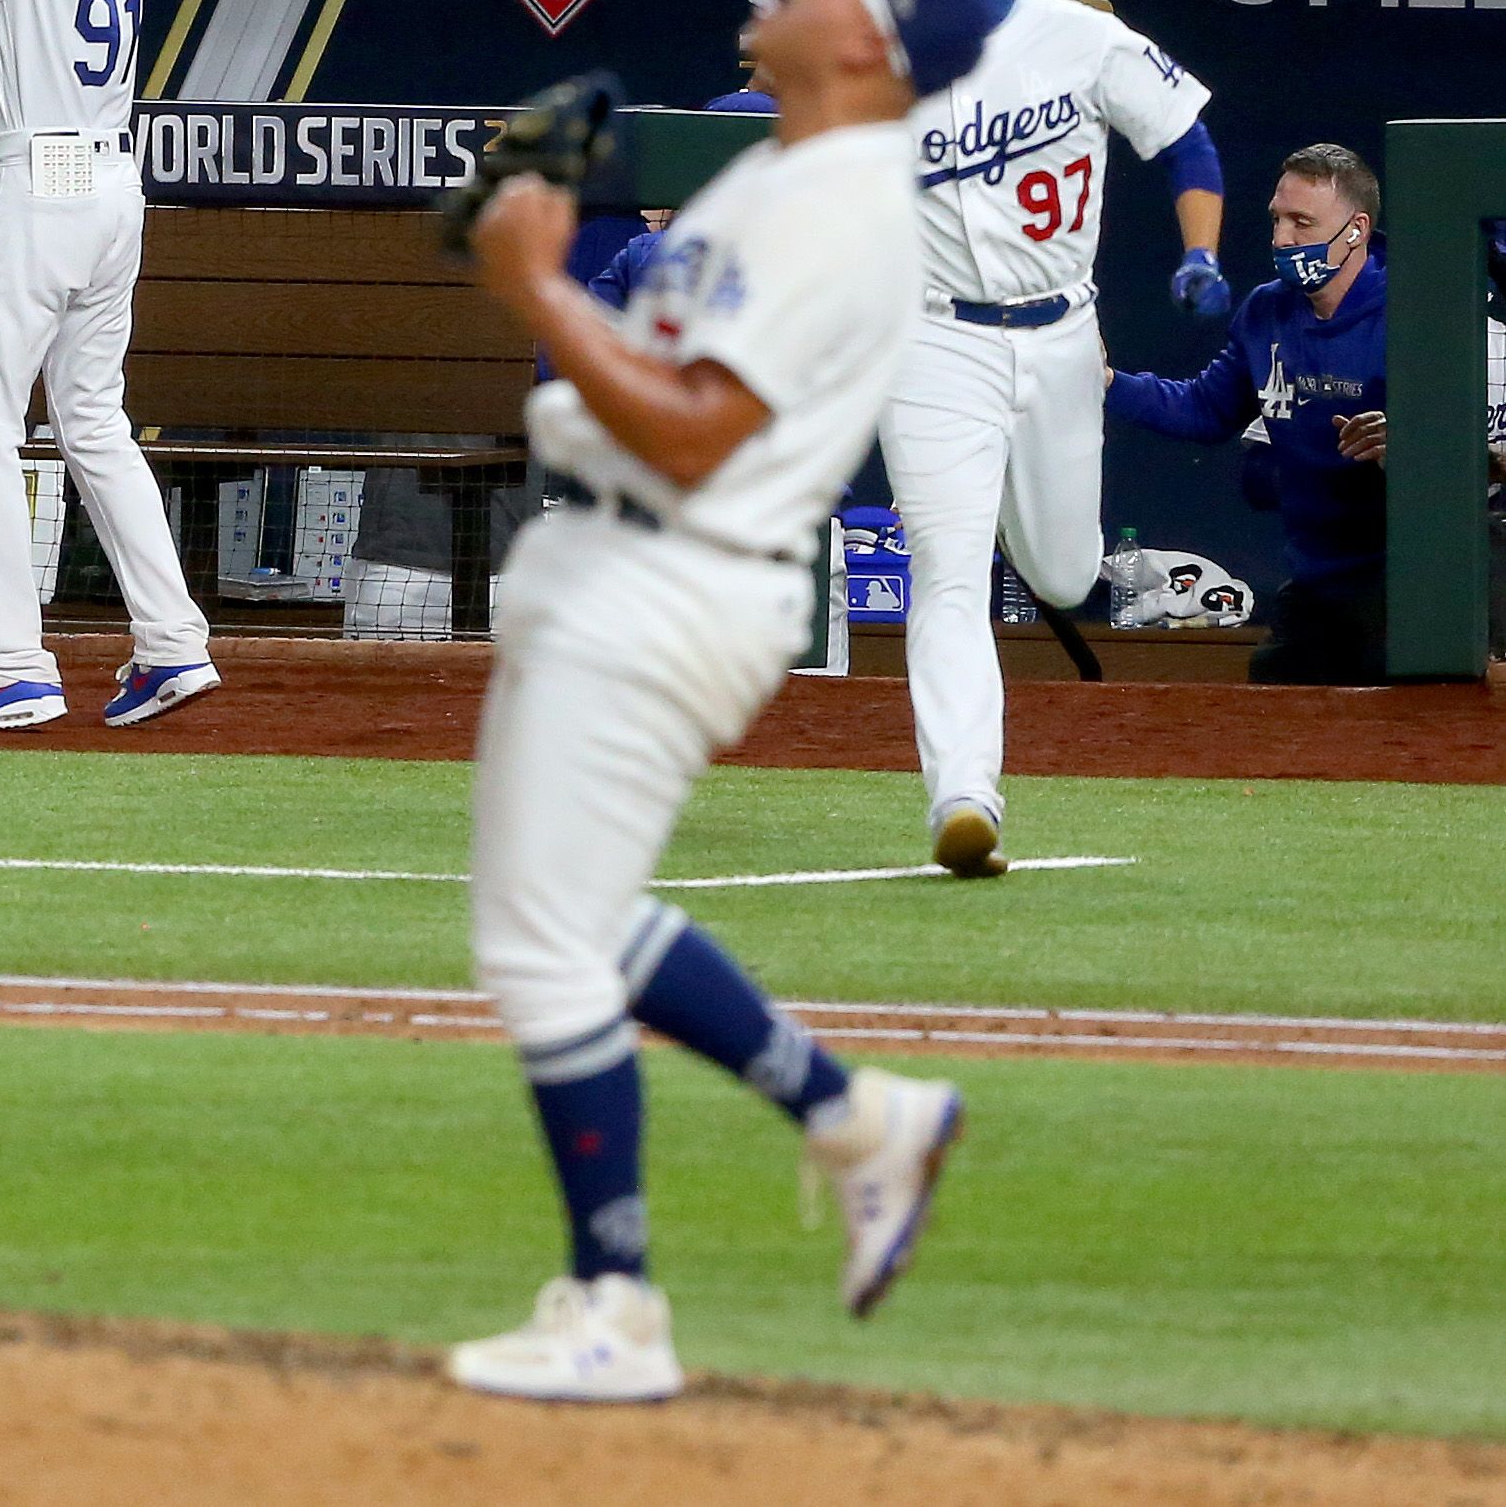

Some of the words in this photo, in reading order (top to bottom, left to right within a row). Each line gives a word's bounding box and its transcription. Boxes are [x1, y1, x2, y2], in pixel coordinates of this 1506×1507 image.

[295, 116, 477, 188] SERIES
[921, 92, 1081, 186] odgers
[1016, 153, 1093, 242] 97
